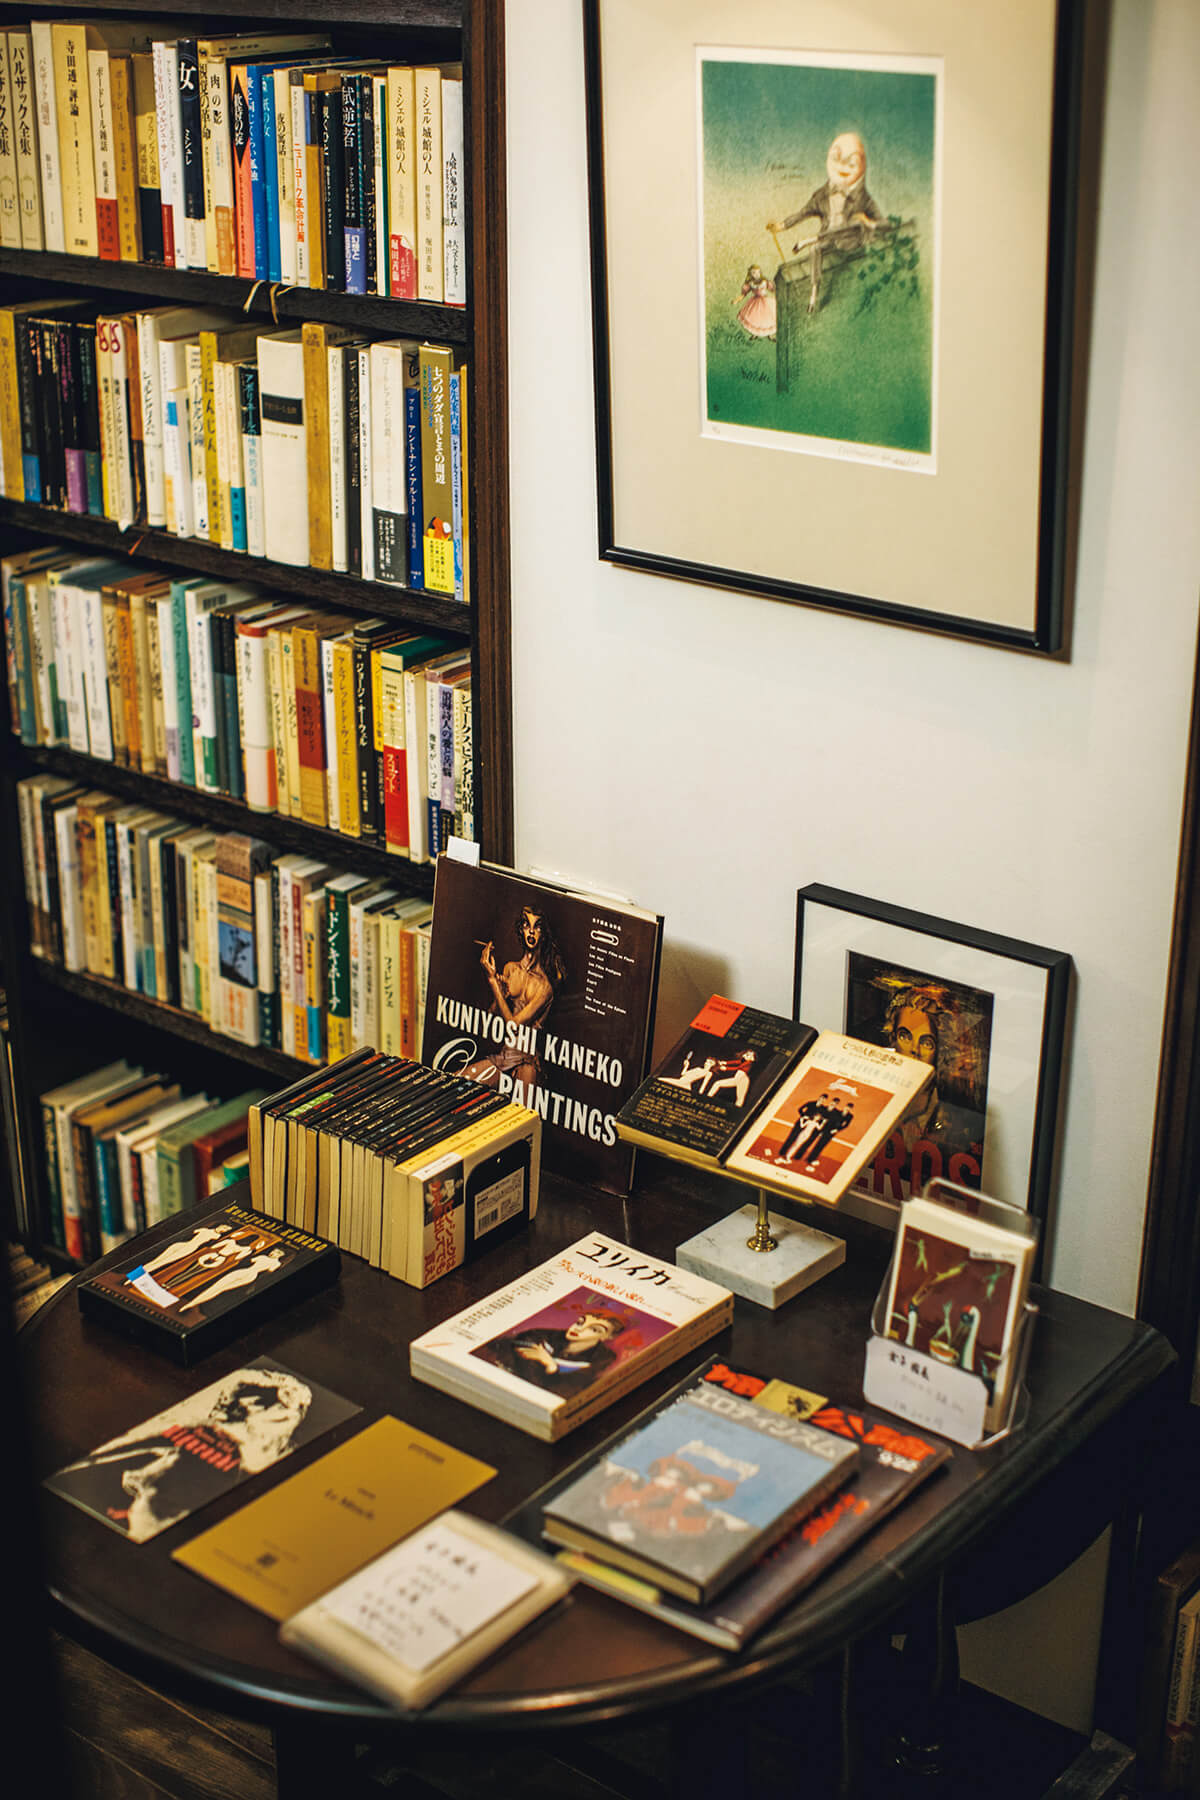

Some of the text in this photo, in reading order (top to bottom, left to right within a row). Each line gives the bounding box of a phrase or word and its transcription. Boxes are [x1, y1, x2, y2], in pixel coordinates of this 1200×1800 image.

[13, 47, 32, 157] バルザック全集
[179, 60, 198, 91] 女
[395, 86, 406, 175] ミシェル城館の人
[422, 86, 433, 175] ミシェル城館の人
[327, 910, 342, 1012] ドン・キホーテ
[436, 994, 623, 1088] KUNIYOSHI KANEKO
[498, 1071, 618, 1147] PAINTINGS
[575, 1241, 673, 1287] ユリイカ
